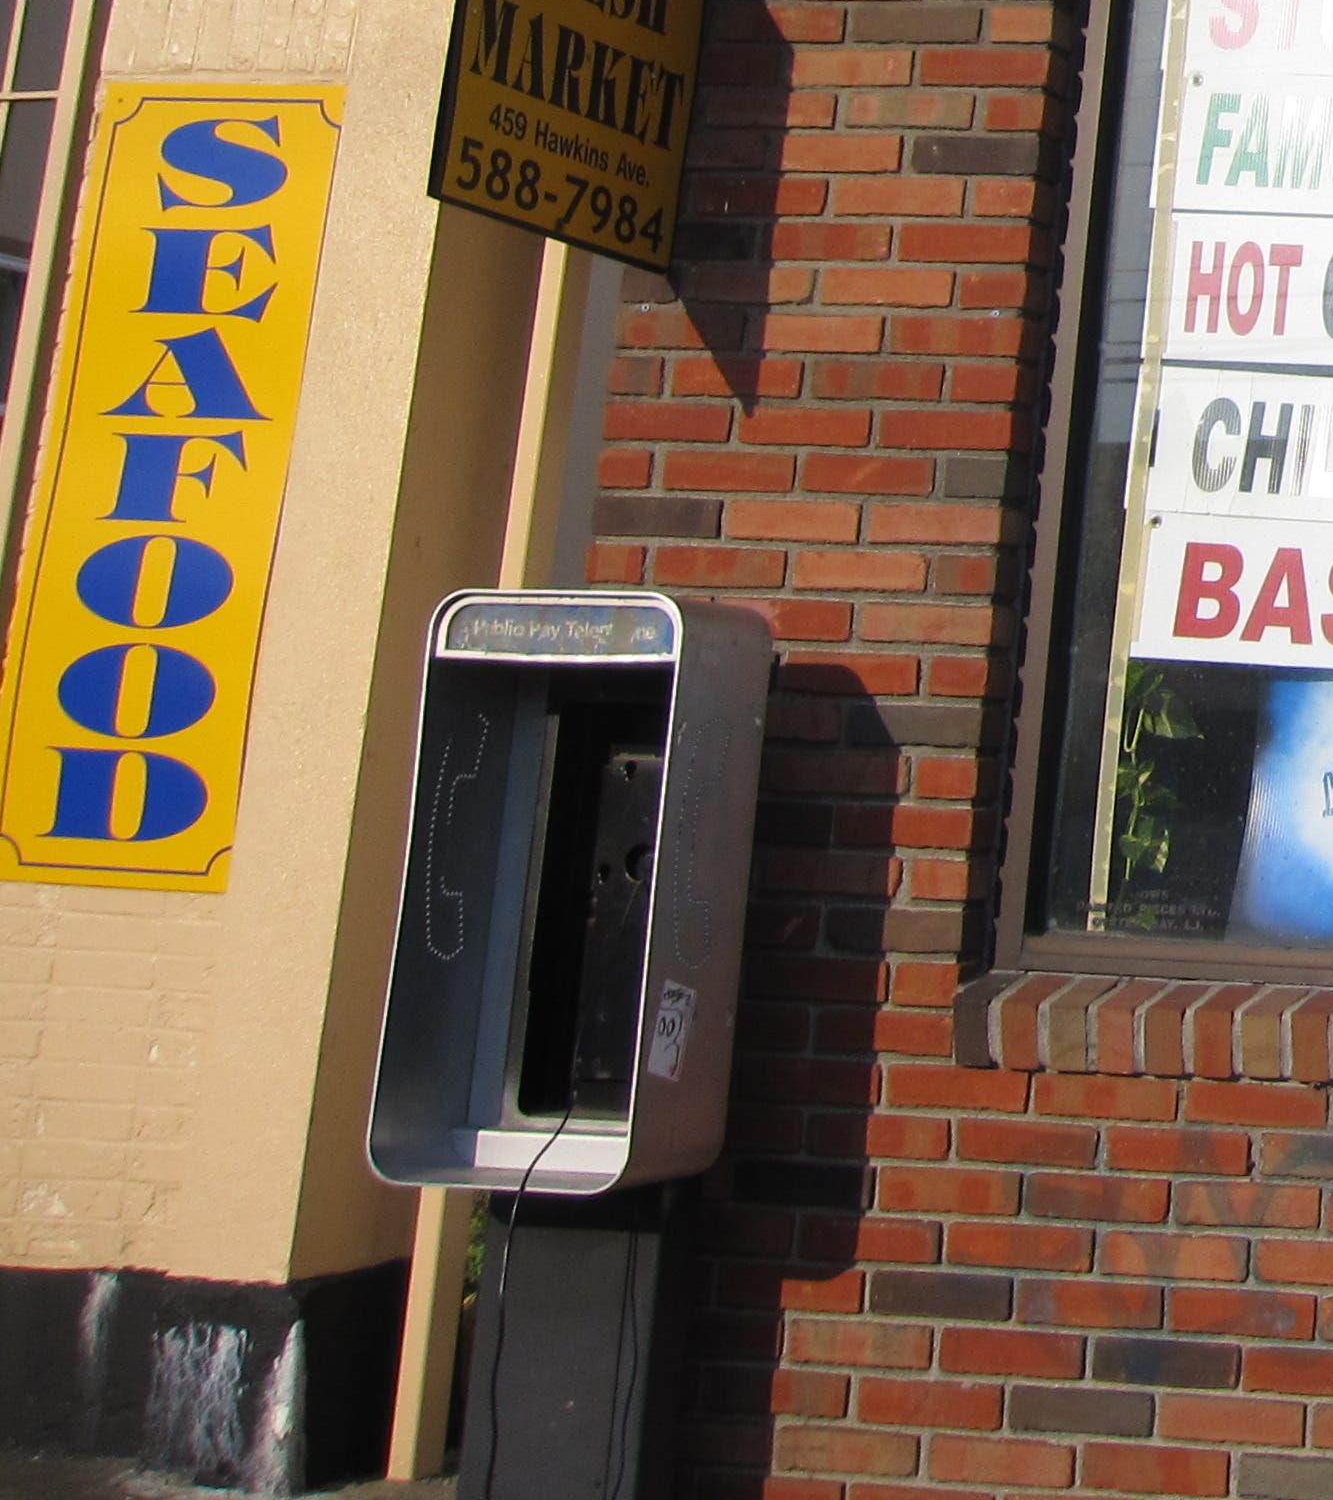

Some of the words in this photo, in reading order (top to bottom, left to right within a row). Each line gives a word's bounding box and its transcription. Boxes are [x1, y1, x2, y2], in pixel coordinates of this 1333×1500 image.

[488, 103, 528, 141] 459
[534, 119, 609, 171] Hawkins
[615, 151, 650, 188] Ave.
[456, 136, 665, 255] 588-7984
[1183, 240, 1304, 337] HOT
[35, 116, 289, 843] SEAFOOD
[474, 618, 526, 639] Public
[529, 620, 561, 642] Pay
